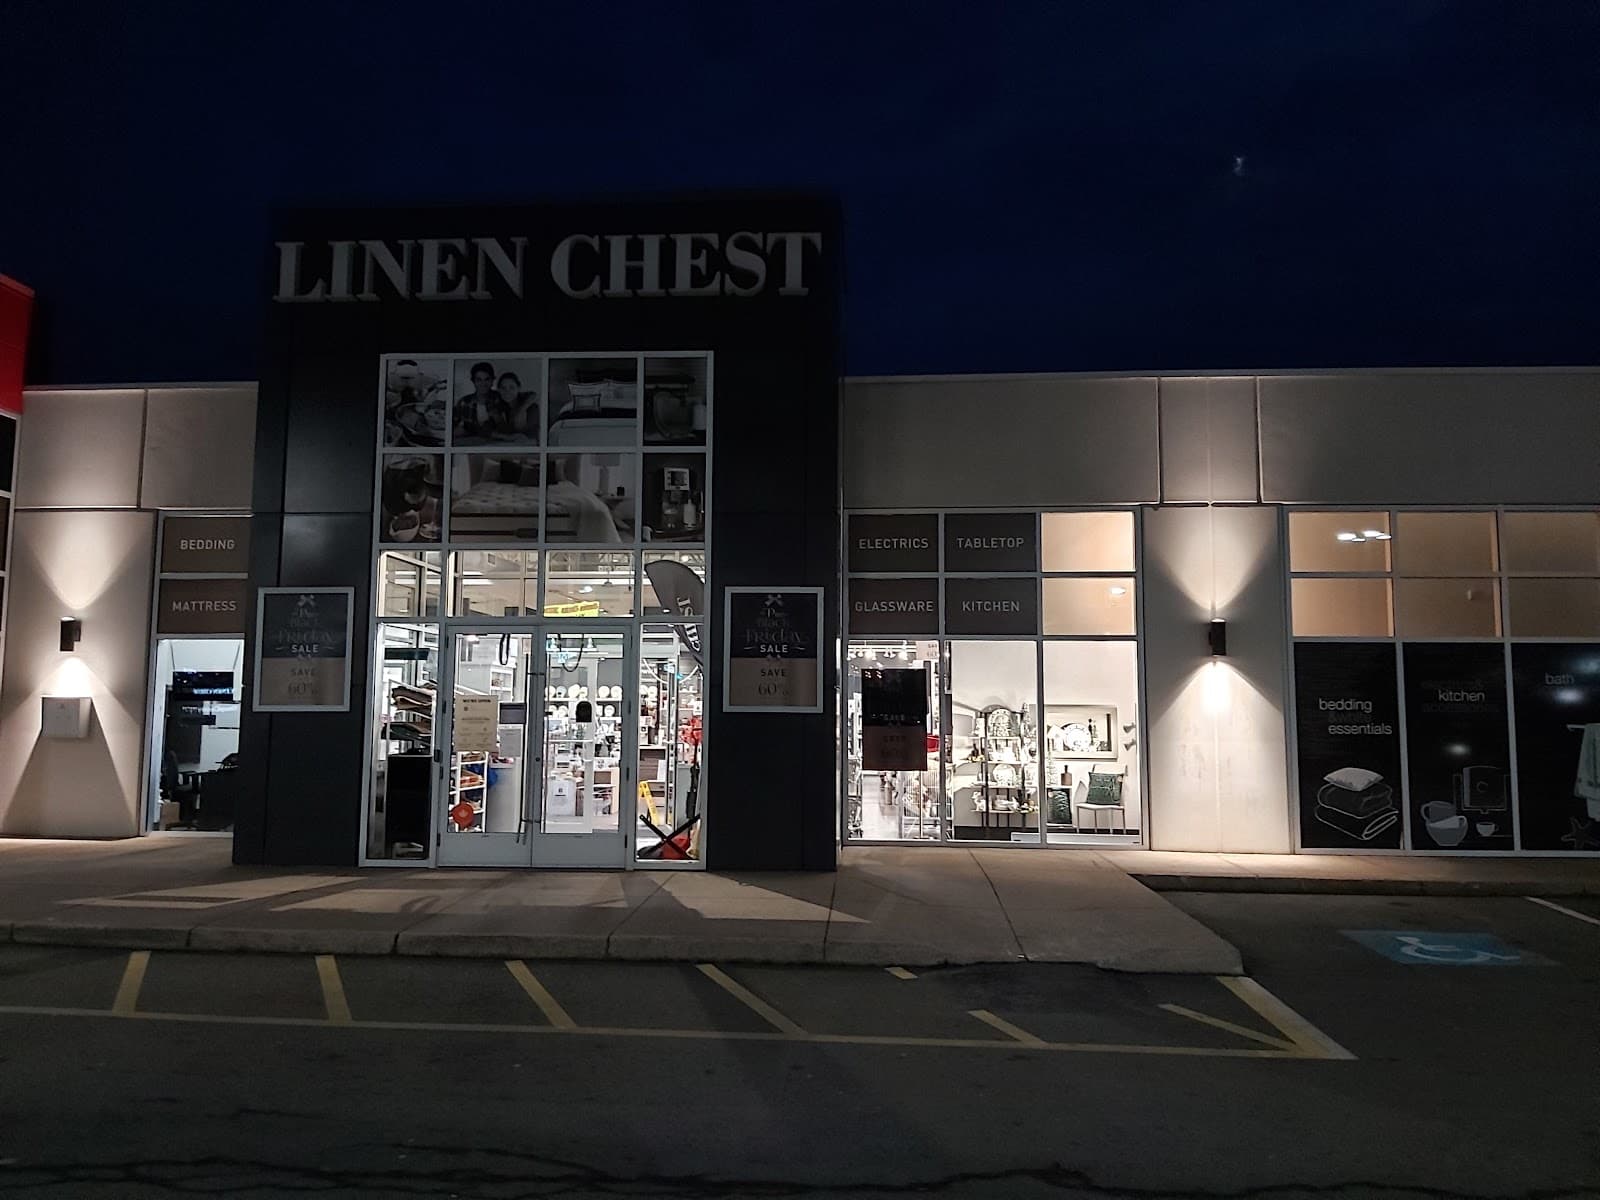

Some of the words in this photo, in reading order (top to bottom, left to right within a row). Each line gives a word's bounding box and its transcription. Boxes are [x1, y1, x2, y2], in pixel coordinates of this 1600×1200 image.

[272, 237, 527, 303] LINEN
[550, 231, 823, 298] CHEST
[179, 539, 235, 551] BEDDING
[858, 537, 930, 550] ELECTRICS
[956, 537, 1025, 549] TABLETOP
[172, 600, 237, 612] MATTRESS
[855, 600, 935, 613] GLASSWARE
[962, 600, 1021, 612] KITCHEN
[290, 644, 320, 653] SALE
[759, 644, 789, 653] SALE
[760, 668, 786, 677] SAVE
[1545, 671, 1575, 685] bath
[1438, 689, 1486, 702] kitchen
[1318, 698, 1373, 714] bedding
[1327, 723, 1393, 735] essentials
